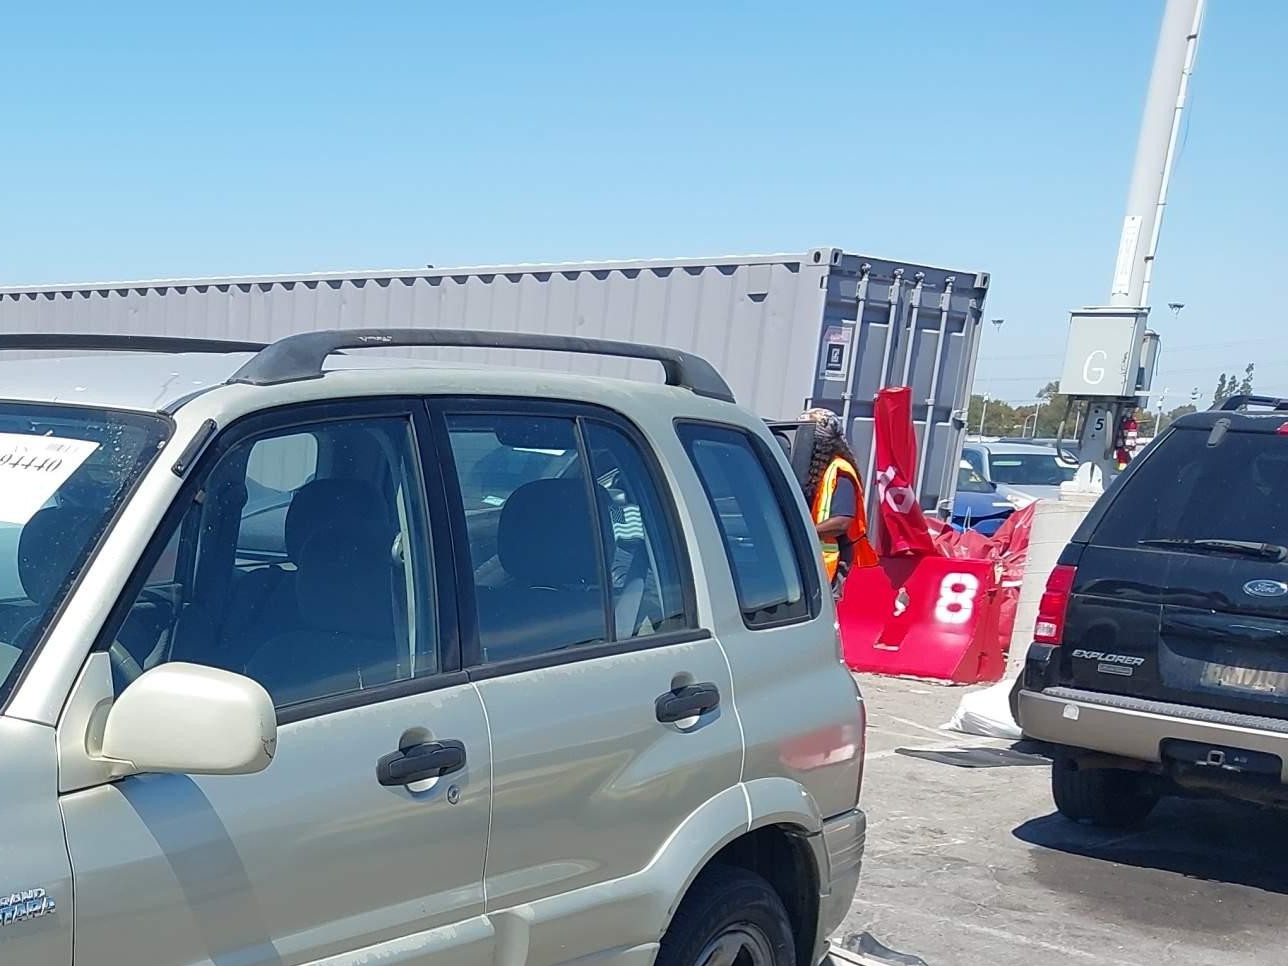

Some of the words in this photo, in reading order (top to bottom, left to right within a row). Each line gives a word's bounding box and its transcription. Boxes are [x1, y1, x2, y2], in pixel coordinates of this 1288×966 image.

[1081, 349, 1108, 385] G
[1094, 417, 1105, 431] 5
[934, 572, 980, 625] 8
[1071, 648, 1145, 667] EXPLORER
